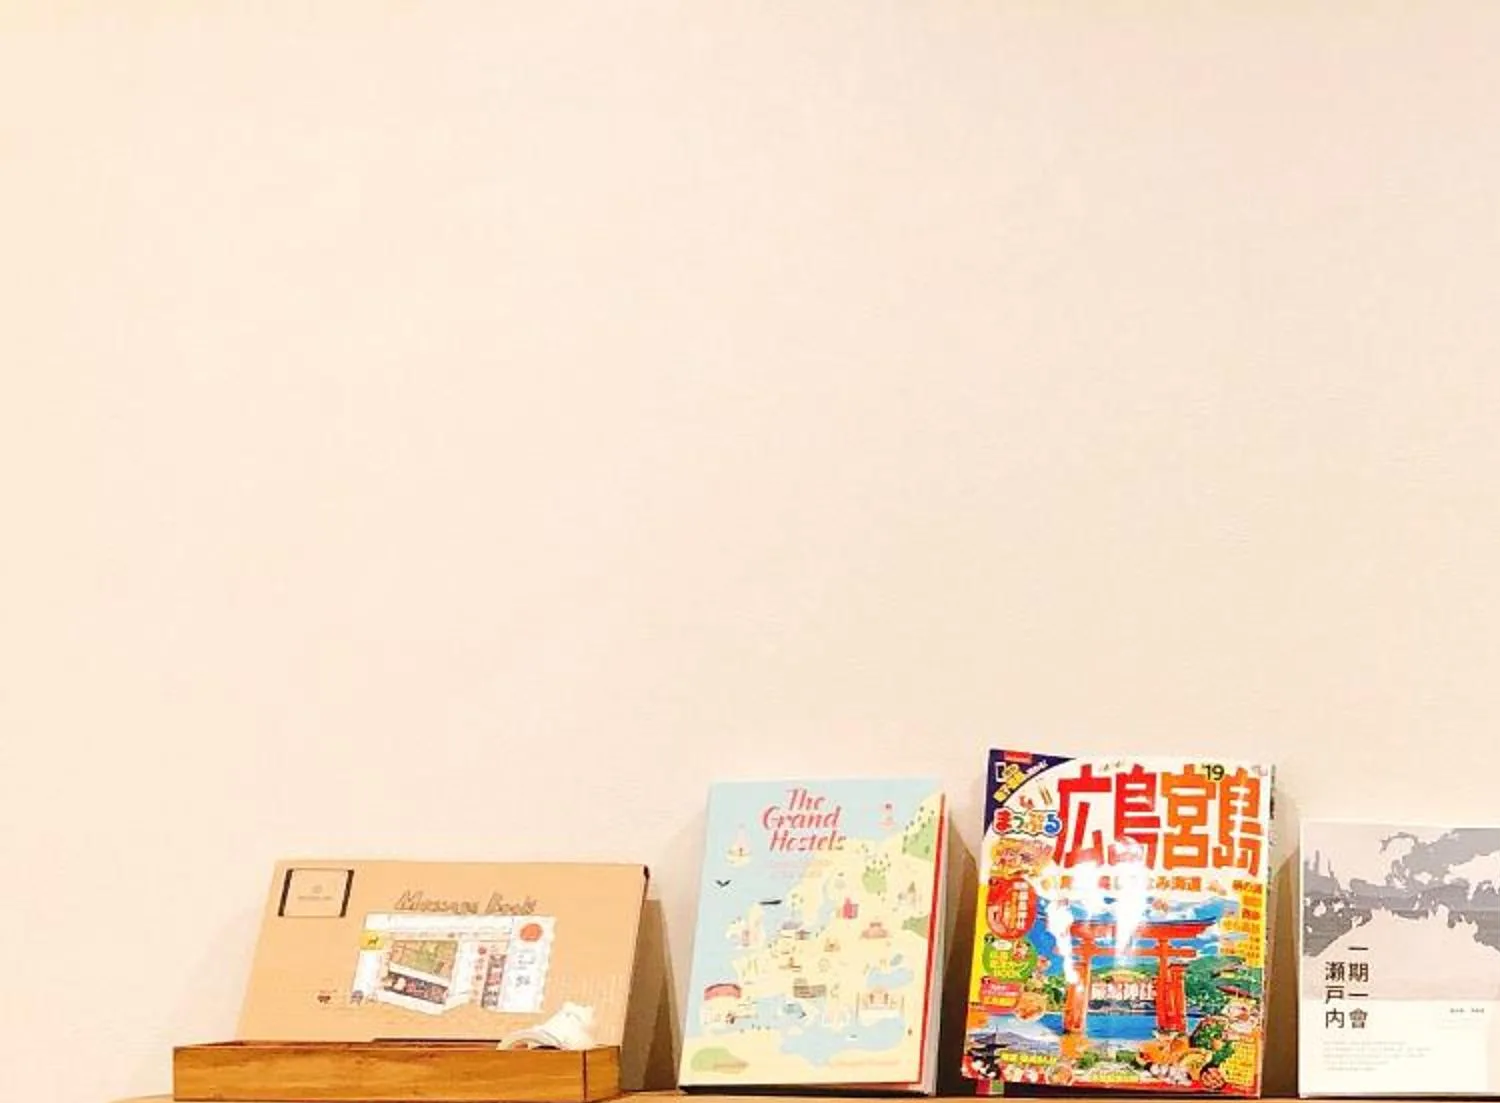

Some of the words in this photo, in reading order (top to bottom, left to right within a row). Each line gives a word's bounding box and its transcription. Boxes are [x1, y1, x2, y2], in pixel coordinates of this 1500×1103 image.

[789, 788, 825, 811] The
[762, 807, 840, 831] Grand
[769, 830, 847, 852] Hostels
[1348, 946, 1369, 1029] 一期一會
